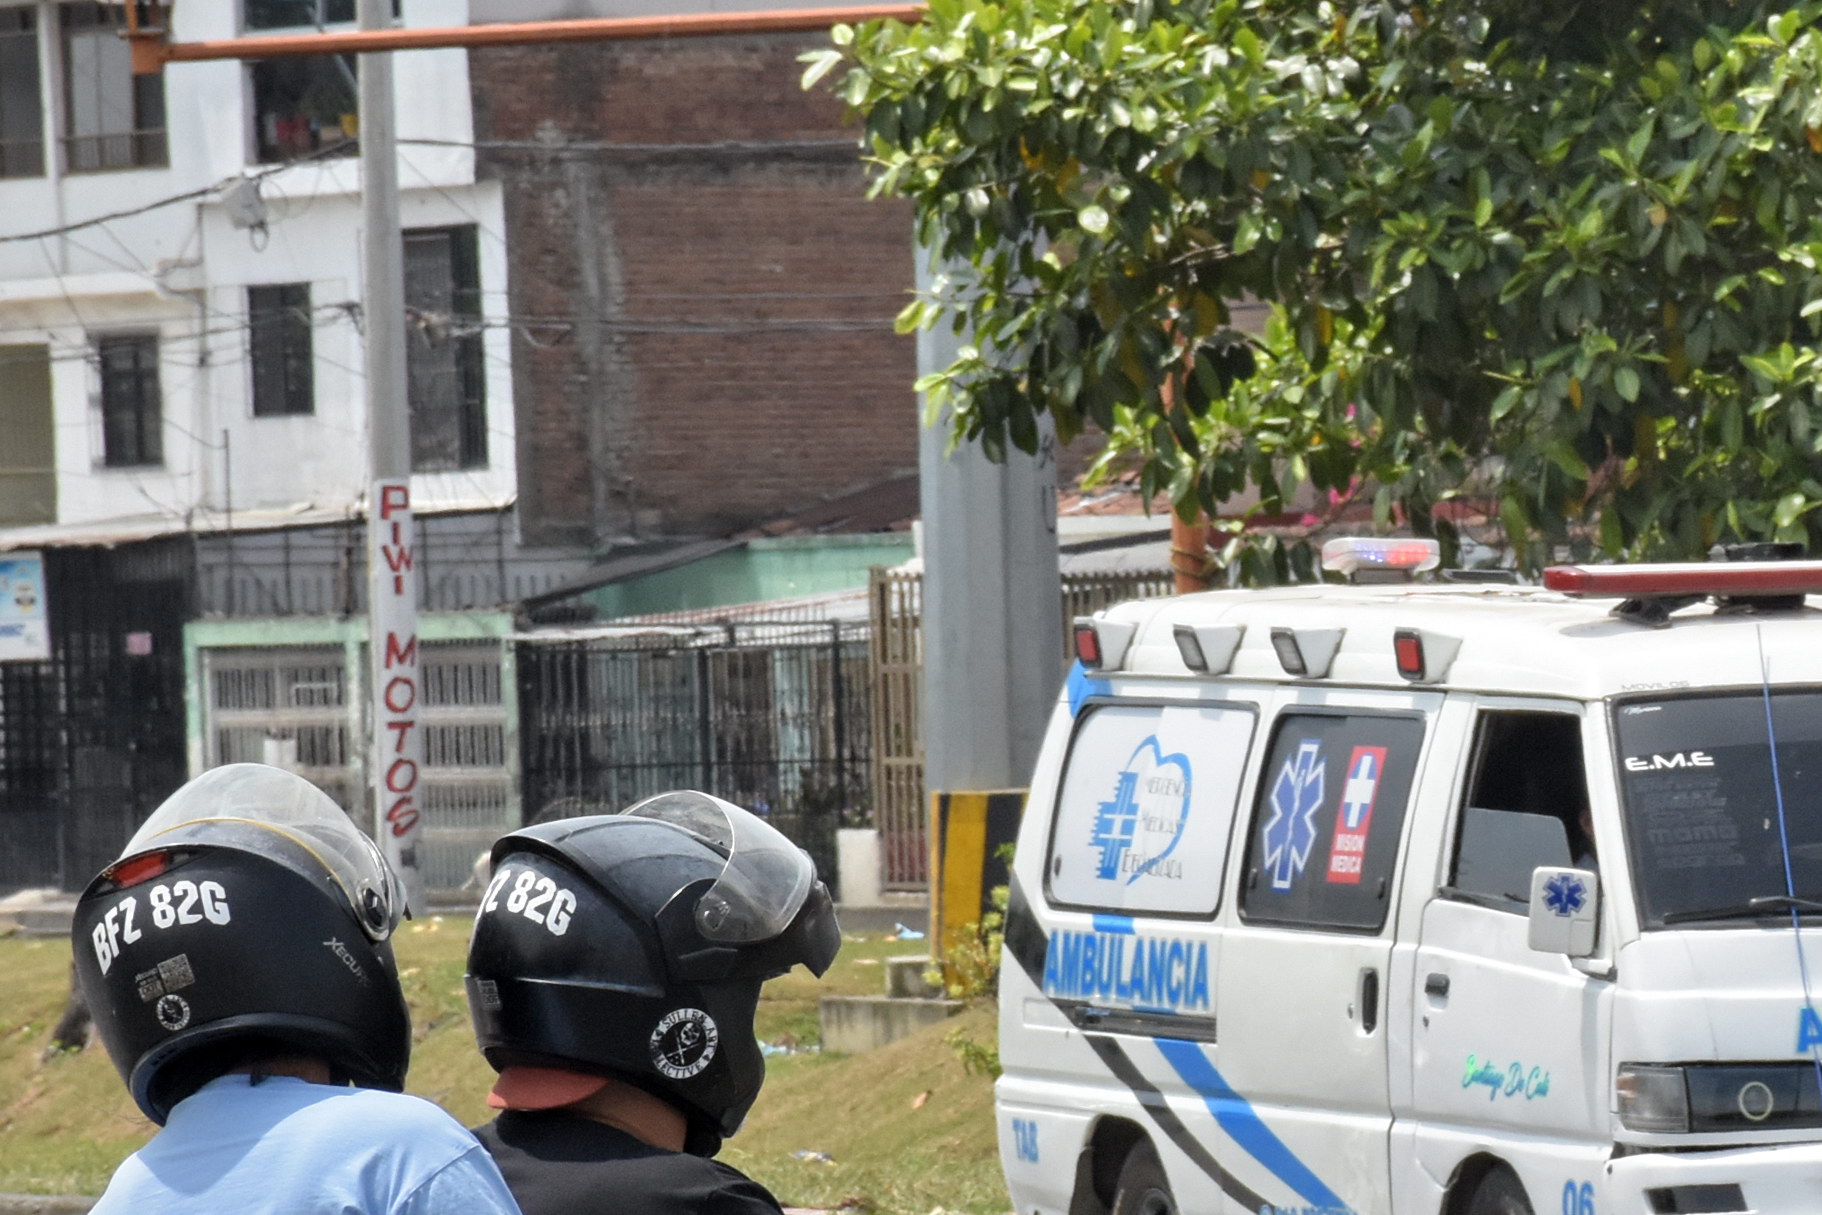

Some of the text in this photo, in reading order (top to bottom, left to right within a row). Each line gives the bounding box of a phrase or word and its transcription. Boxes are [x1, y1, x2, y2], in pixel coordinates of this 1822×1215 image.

[380, 485, 419, 838] PIWI MOTOS
[1625, 751, 1715, 771] E.M.E
[92, 880, 232, 976] BFZ 82G
[507, 869, 577, 937] 82G
[1043, 929, 1210, 1010] AMBULANCIA
[1012, 1117, 1039, 1164] TAB
